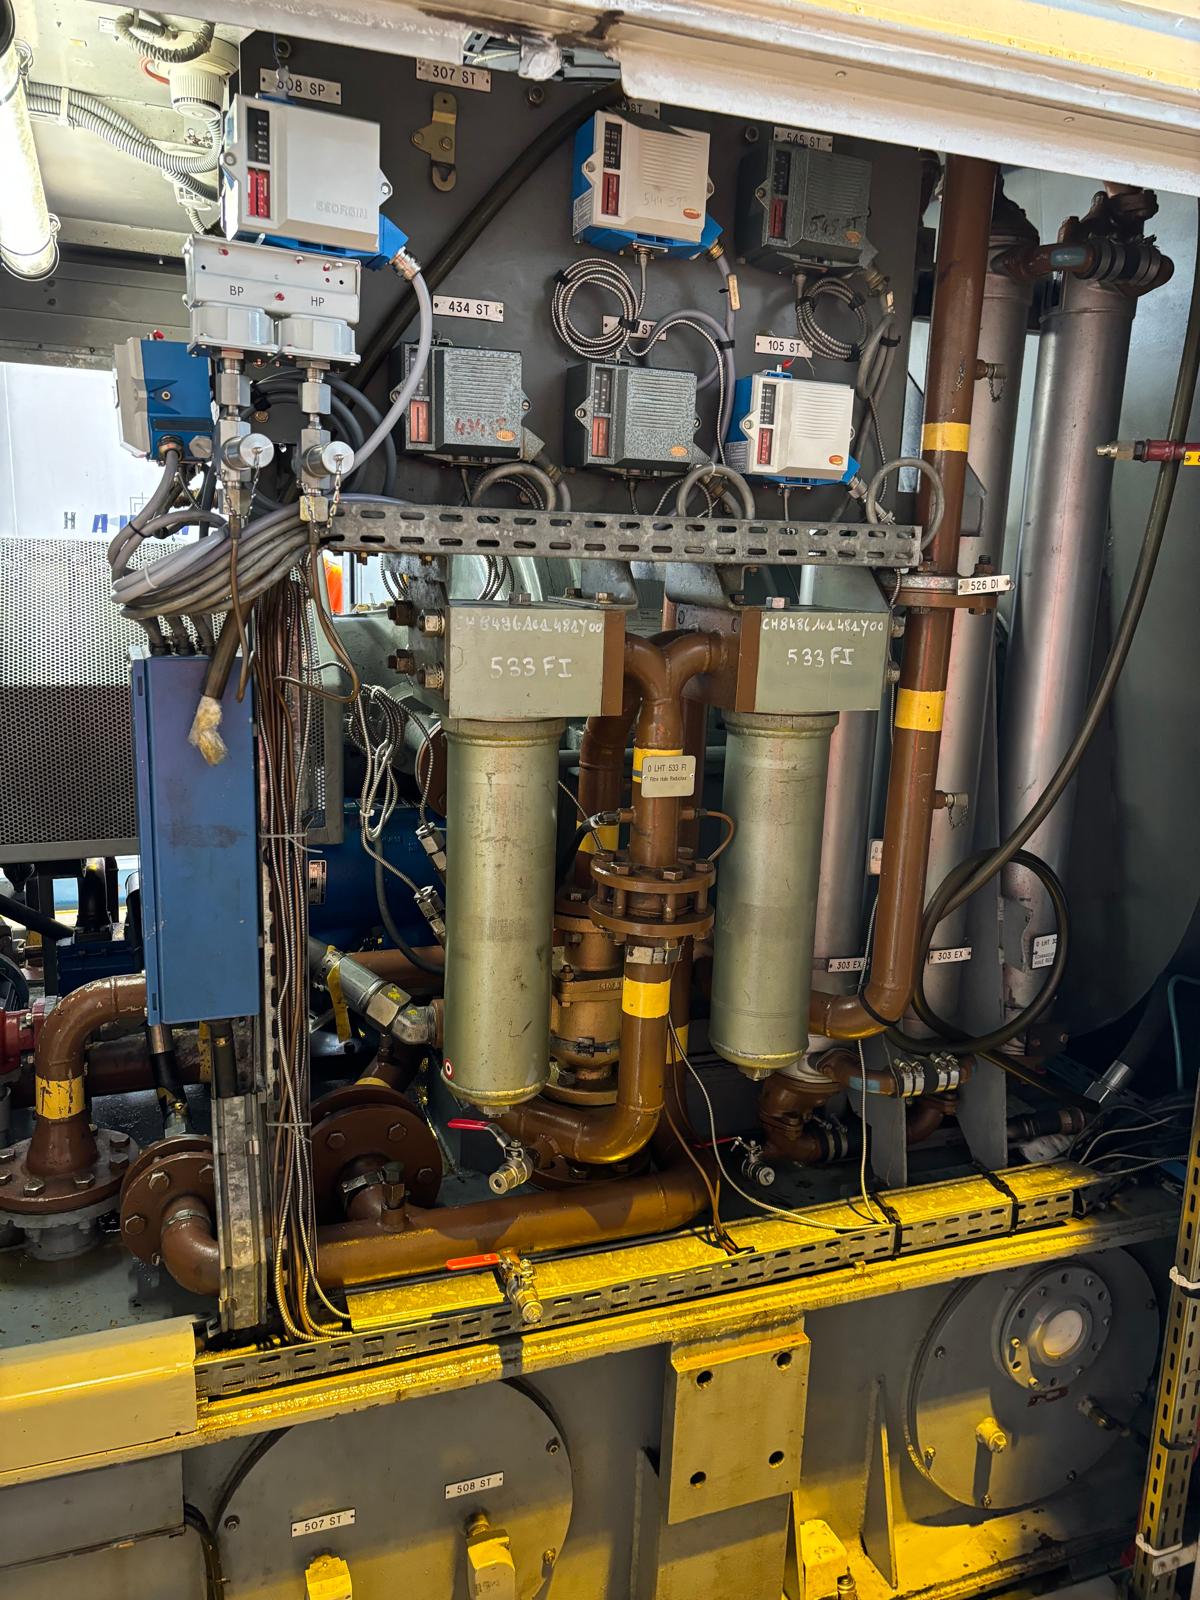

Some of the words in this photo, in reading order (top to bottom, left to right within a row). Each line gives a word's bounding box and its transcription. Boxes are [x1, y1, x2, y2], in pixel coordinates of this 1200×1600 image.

[432, 65, 455, 79] 307
[462, 71, 476, 85] ST
[310, 83, 325, 96] SP
[809, 137, 820, 148] ST
[229, 285, 244, 297] BP
[311, 296, 325, 307] HP
[448, 301, 470, 314] 434
[476, 304, 489, 316] ST
[641, 323, 654, 335] ST
[769, 340, 784, 351] 105
[789, 342, 801, 353] ST
[971, 581, 987, 591] 526
[991, 578, 999, 588] DI
[786, 648, 824, 667] 533
[831, 646, 855, 665] FI
[490, 656, 536, 678] 533
[543, 655, 572, 678] FI
[937, 951, 951, 960] 303
[952, 950, 964, 959] EX
[836, 961, 851, 970] 303
[852, 960, 862, 969] EX
[457, 1483, 475, 1494] 508
[480, 1478, 492, 1488] ST
[305, 1519, 324, 1532] 507
[329, 1515, 342, 1527] ST
